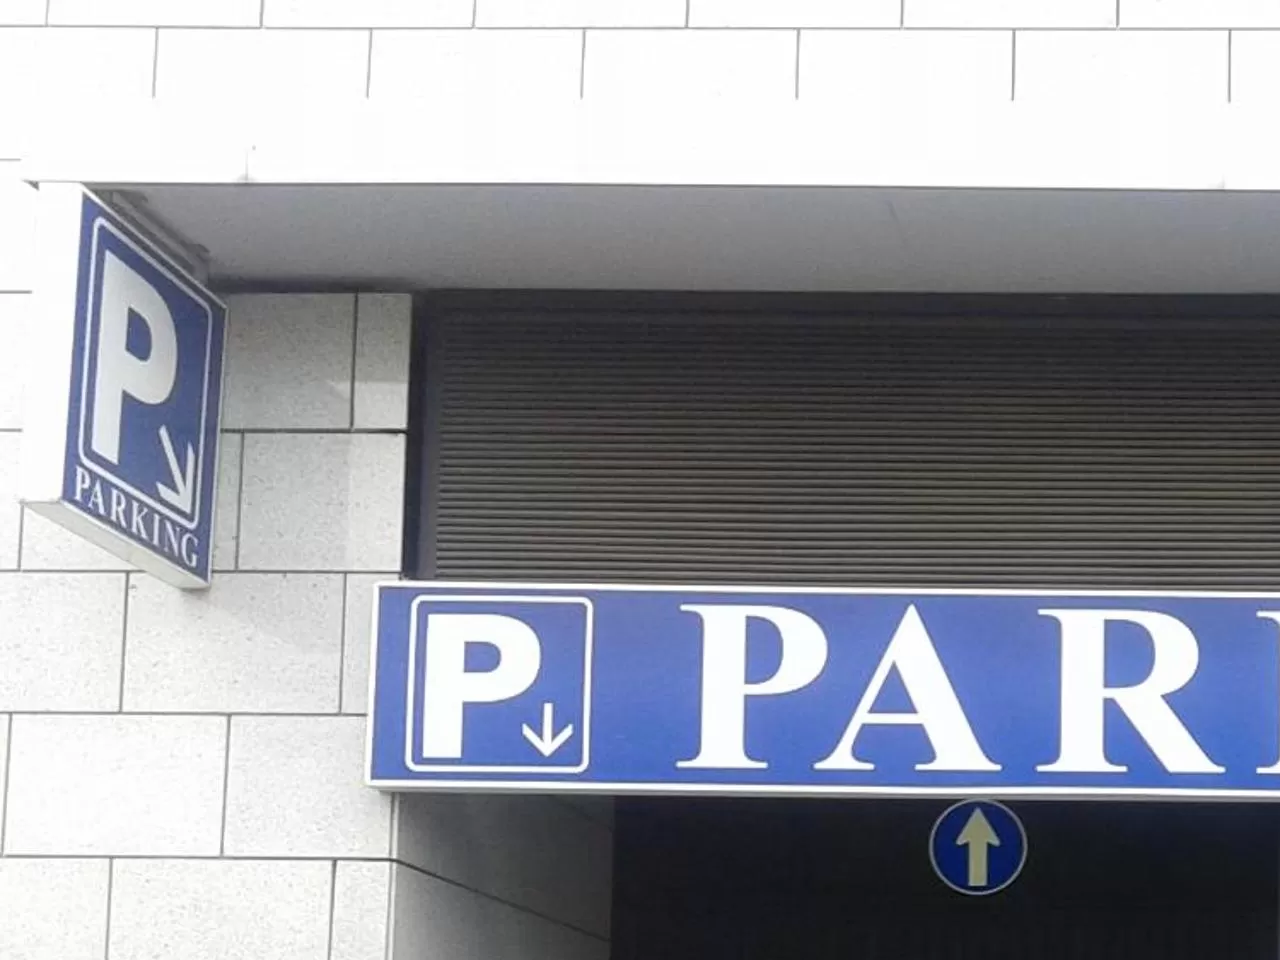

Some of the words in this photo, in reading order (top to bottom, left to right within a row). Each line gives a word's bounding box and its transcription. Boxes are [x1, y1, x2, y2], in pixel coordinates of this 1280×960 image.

[91, 249, 178, 466] P
[74, 465, 200, 570] PARKING
[422, 613, 541, 759] P
